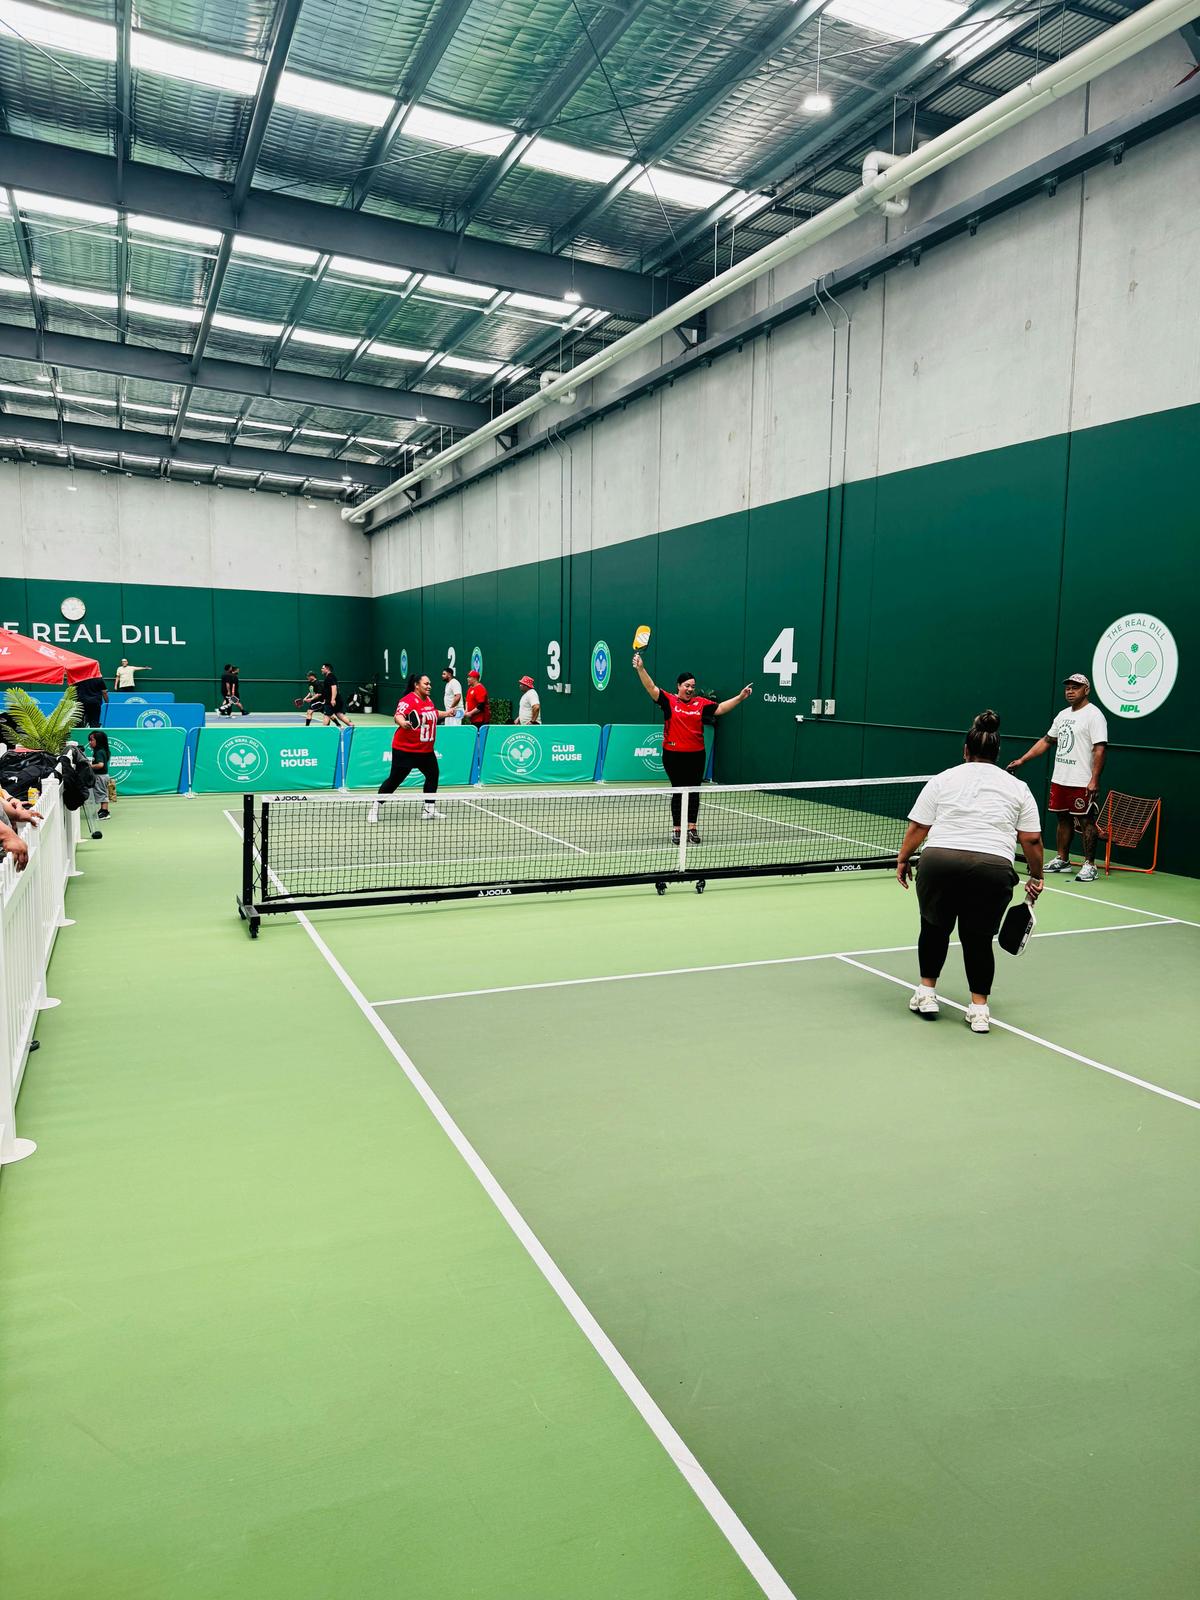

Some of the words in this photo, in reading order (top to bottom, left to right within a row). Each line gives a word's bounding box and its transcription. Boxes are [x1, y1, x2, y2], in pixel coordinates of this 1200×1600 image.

[32, 622, 111, 643] REAL
[121, 624, 186, 646] DILL
[1107, 625, 1123, 640] THE
[1125, 619, 1147, 628] REAL
[1149, 622, 1166, 640] DILL
[384, 648, 389, 673] 1
[447, 646, 456, 677] 2
[547, 640, 561, 680] 3
[763, 627, 798, 687] 4
[763, 693, 777, 702] Club
[778, 694, 797, 704] House
[1120, 704, 1140, 713] NPL
[280, 748, 309, 757] CLUB
[551, 744, 575, 752] CLUB
[634, 747, 660, 757] NPL
[551, 753, 583, 762] HOUSE
[280, 758, 318, 768] HOUSE
[485, 888, 512, 896] JOOLA
